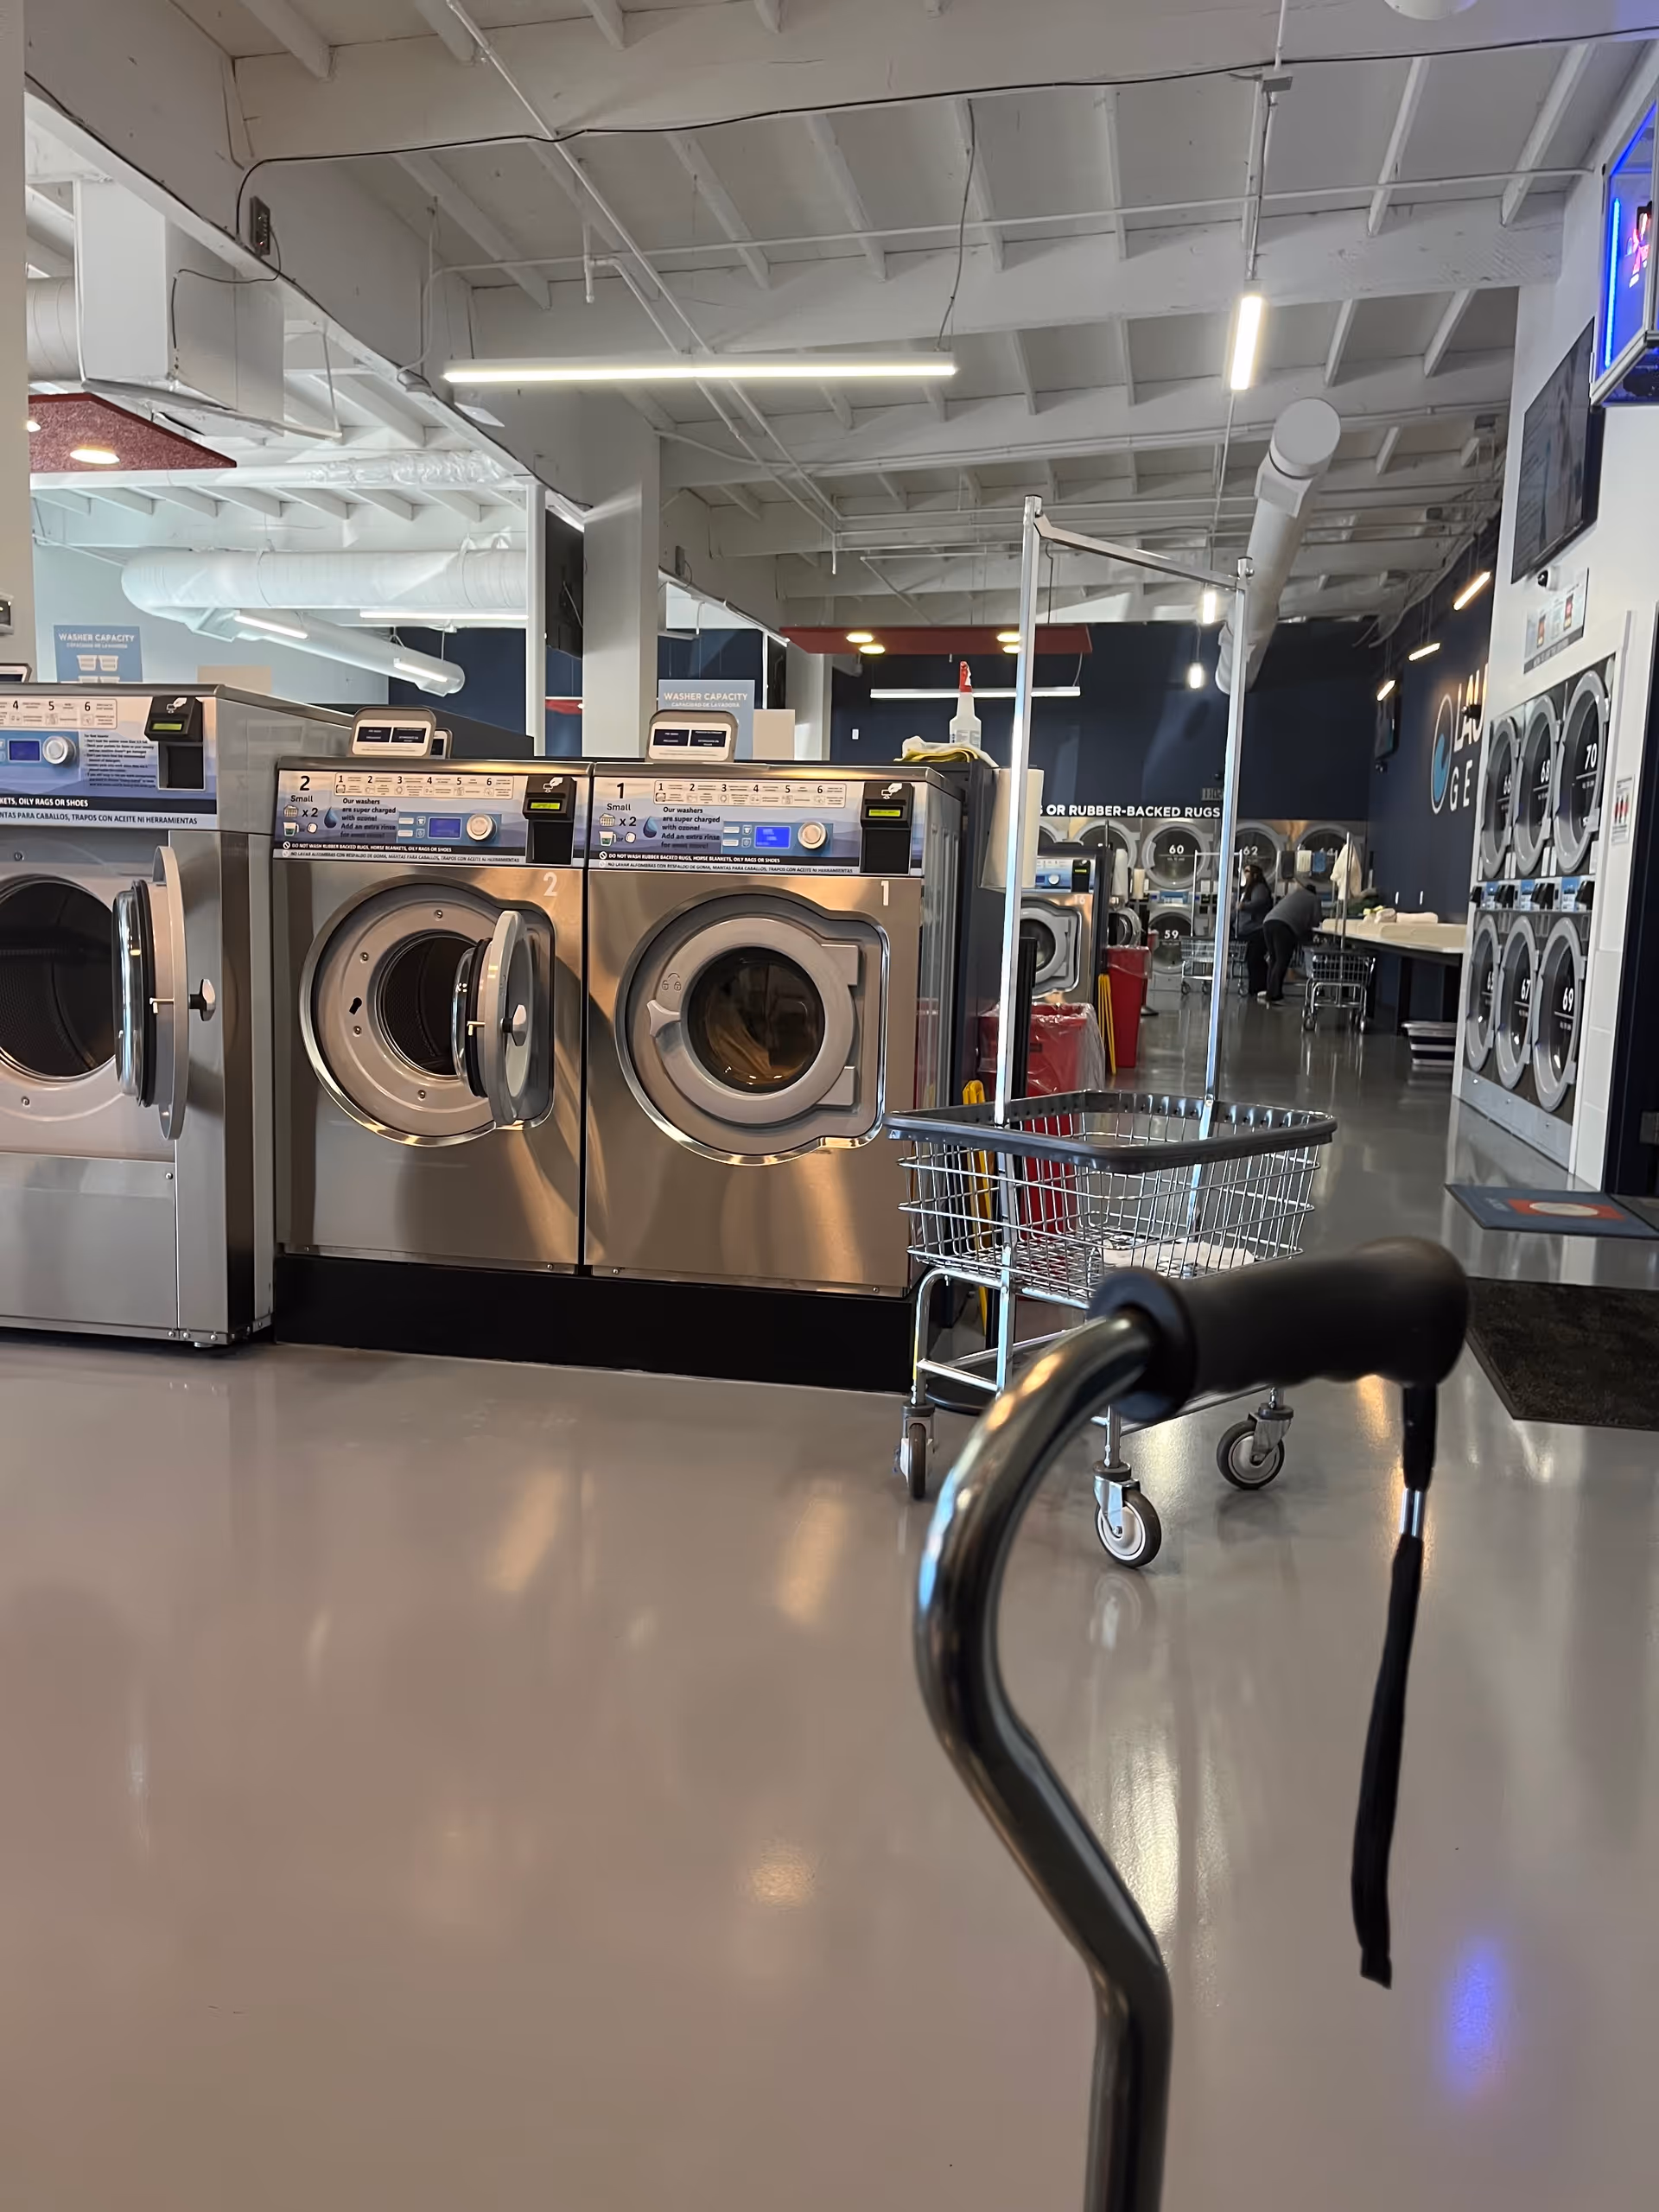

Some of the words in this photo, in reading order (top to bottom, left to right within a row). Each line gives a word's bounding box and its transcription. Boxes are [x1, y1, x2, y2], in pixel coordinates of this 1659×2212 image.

[94, 633, 135, 643] CAPACITY
[13, 701, 19, 710] 4
[48, 701, 54, 711] 5
[85, 702, 91, 711] 6
[1585, 742, 1597, 771] 70
[1541, 760, 1550, 783] 68
[299, 775, 310, 791] 2
[616, 782, 624, 799] 1
[785, 785, 791, 793] 5
[35, 798, 53, 807] RAGS
[67, 799, 88, 808] SHOES
[607, 803, 631, 811] Small
[310, 808, 318, 817] 2
[1046, 804, 1065, 816] OR
[1069, 805, 1180, 817] RUBBER-BACKED
[1185, 806, 1220, 817] RUGS
[36, 812, 70, 822] CABALLOS,
[629, 817, 637, 827] 2
[1169, 844, 1185, 855] 60
[1243, 846, 1258, 856] 62
[543, 872, 557, 896] 2
[881, 880, 889, 906] 1
[1164, 930, 1179, 939] 59
[1521, 978, 1531, 1000] 67
[1562, 987, 1573, 1012] 69
